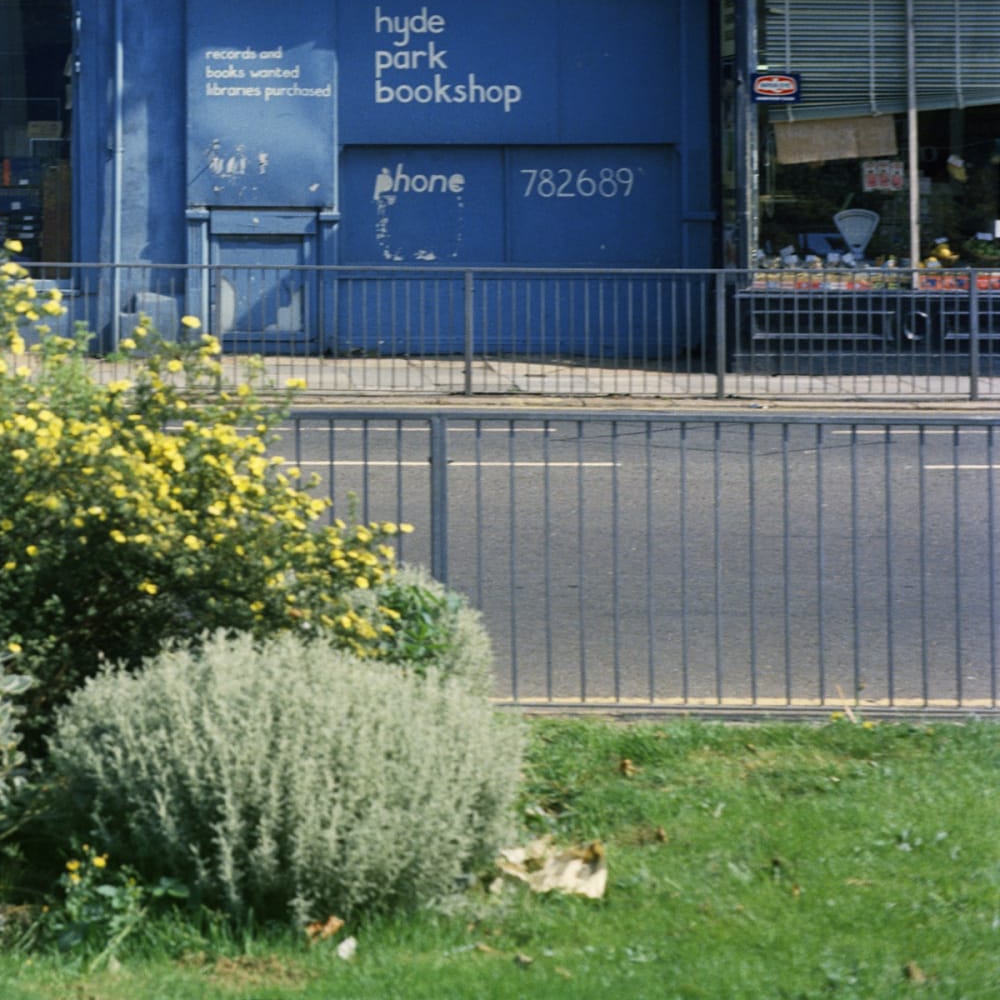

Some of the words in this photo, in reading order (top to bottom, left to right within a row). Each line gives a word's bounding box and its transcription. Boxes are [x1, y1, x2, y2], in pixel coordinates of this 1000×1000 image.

[375, 6, 446, 47] hyde
[205, 46, 257, 59] records
[259, 46, 283, 59] and
[375, 41, 447, 78] park
[205, 65, 245, 78] books
[249, 65, 300, 78] wanted
[205, 82, 261, 96] libraries
[264, 83, 331, 102] purchased
[375, 73, 522, 112] bookshop
[373, 163, 465, 200] phone
[520, 168, 635, 198] 782689
